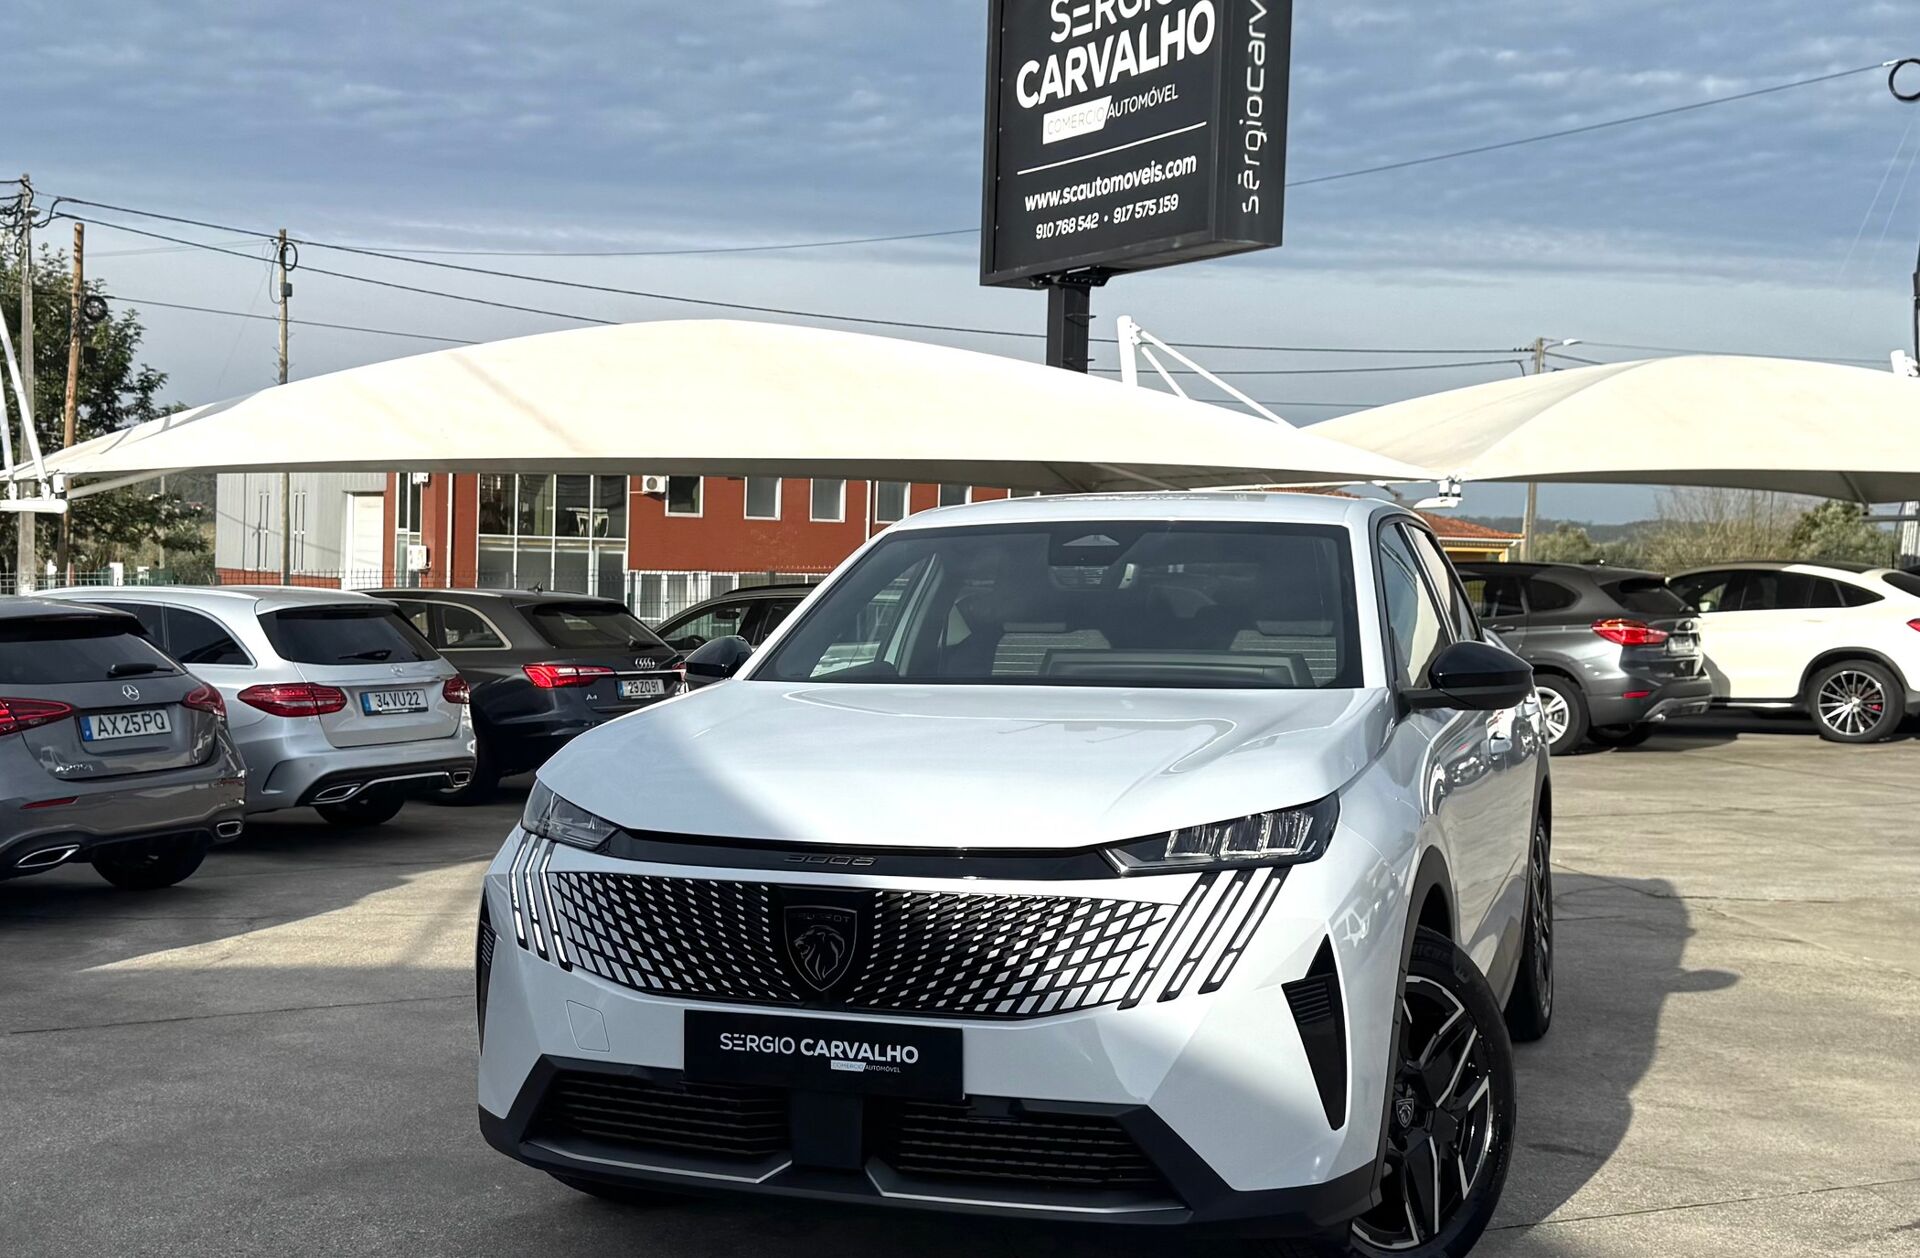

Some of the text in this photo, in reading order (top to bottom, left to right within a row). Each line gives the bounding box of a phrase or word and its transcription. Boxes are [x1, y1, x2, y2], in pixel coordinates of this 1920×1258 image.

[1016, 0, 1215, 109] CARVALHO
[1106, 84, 1179, 120] AUTOMÓVEL
[1024, 155, 1197, 212] www.scautomoveis.com
[1035, 193, 1179, 240] 910 768 542 917 575 159
[375, 691, 421, 708] 34VU22
[97, 711, 166, 737] AX25PQ
[799, 1038, 919, 1064] CARVALHO
